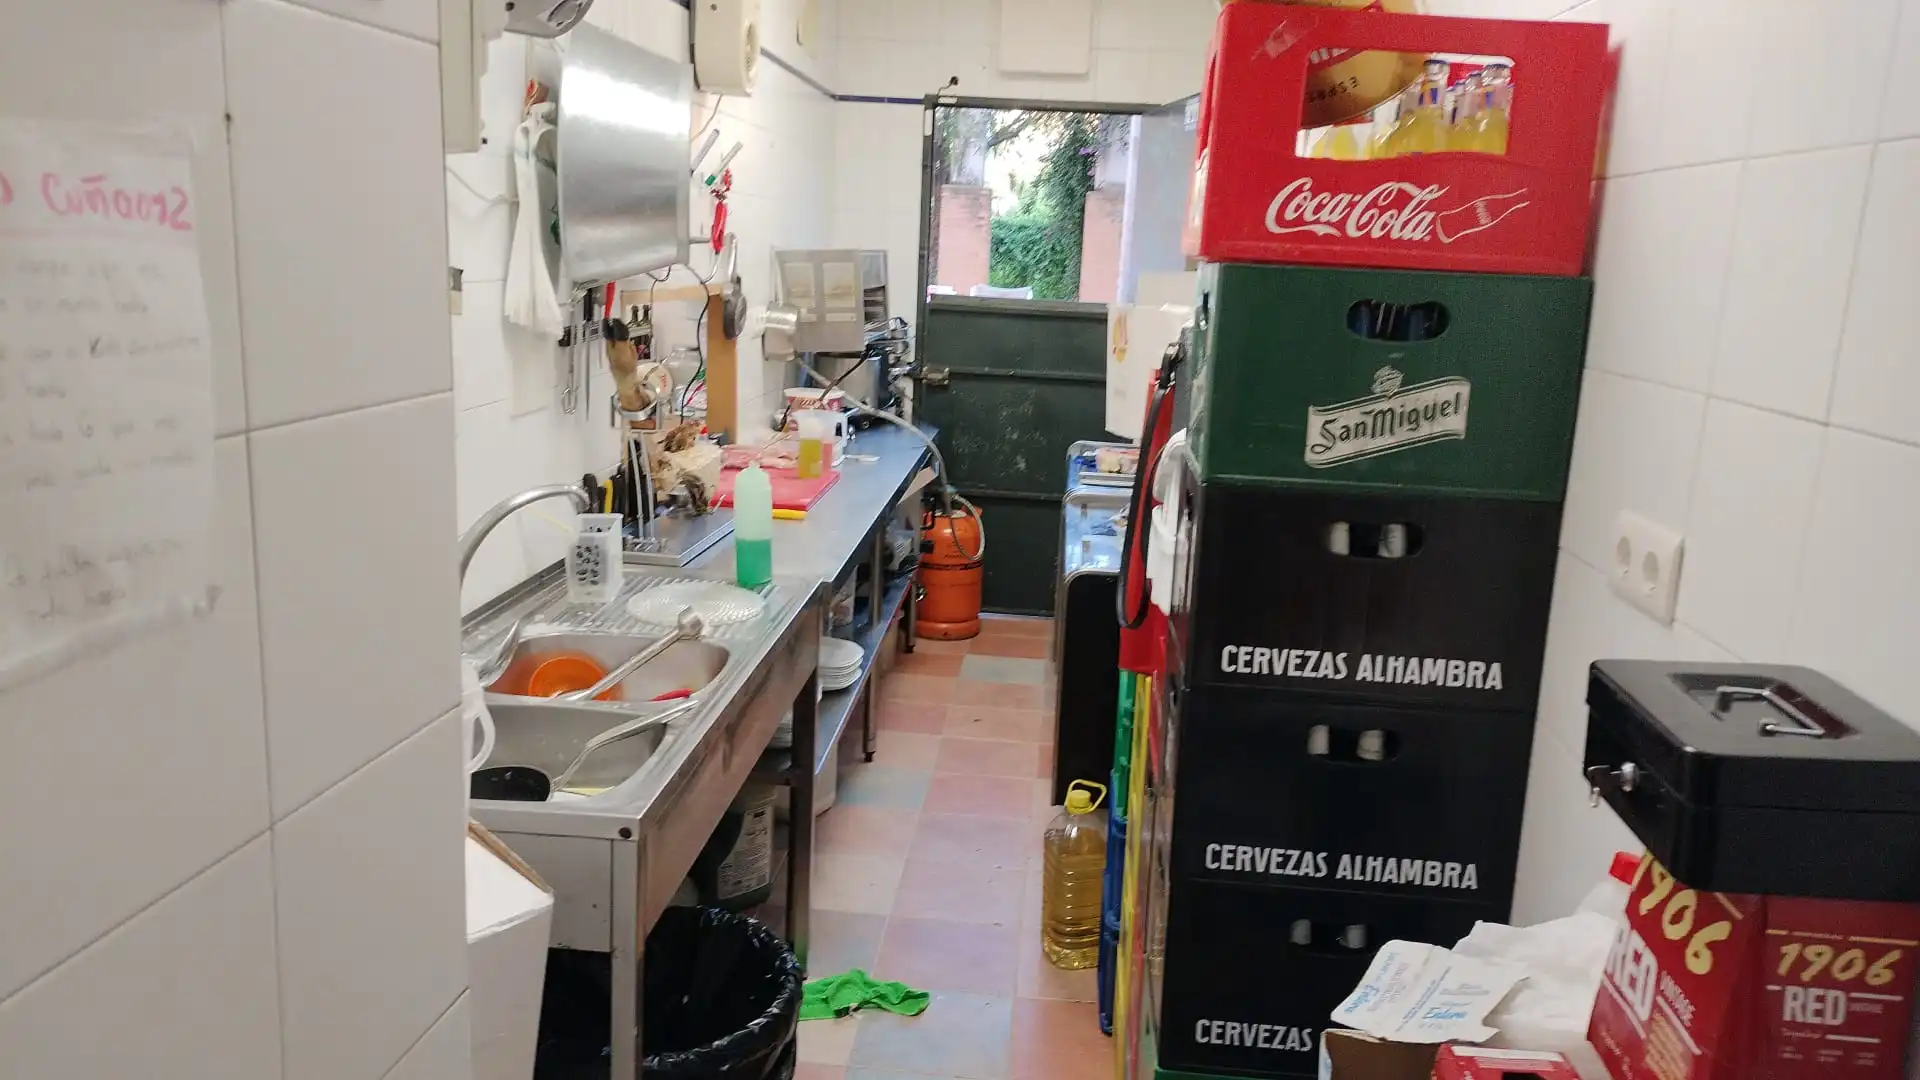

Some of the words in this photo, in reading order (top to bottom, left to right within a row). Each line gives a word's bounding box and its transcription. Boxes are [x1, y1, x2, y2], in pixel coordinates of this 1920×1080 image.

[1265, 177, 1450, 242] Coca-Cola
[1221, 644, 1348, 680] CERVEZAS
[1355, 653, 1503, 691] ALHAMBRA
[1204, 843, 1328, 879] CERVEZAS
[1335, 854, 1479, 890] ALHAMBRA
[1776, 943, 1904, 986] 1906
[1782, 985, 1848, 1026] RED
[1195, 1019, 1313, 1052] CERVEZAS
